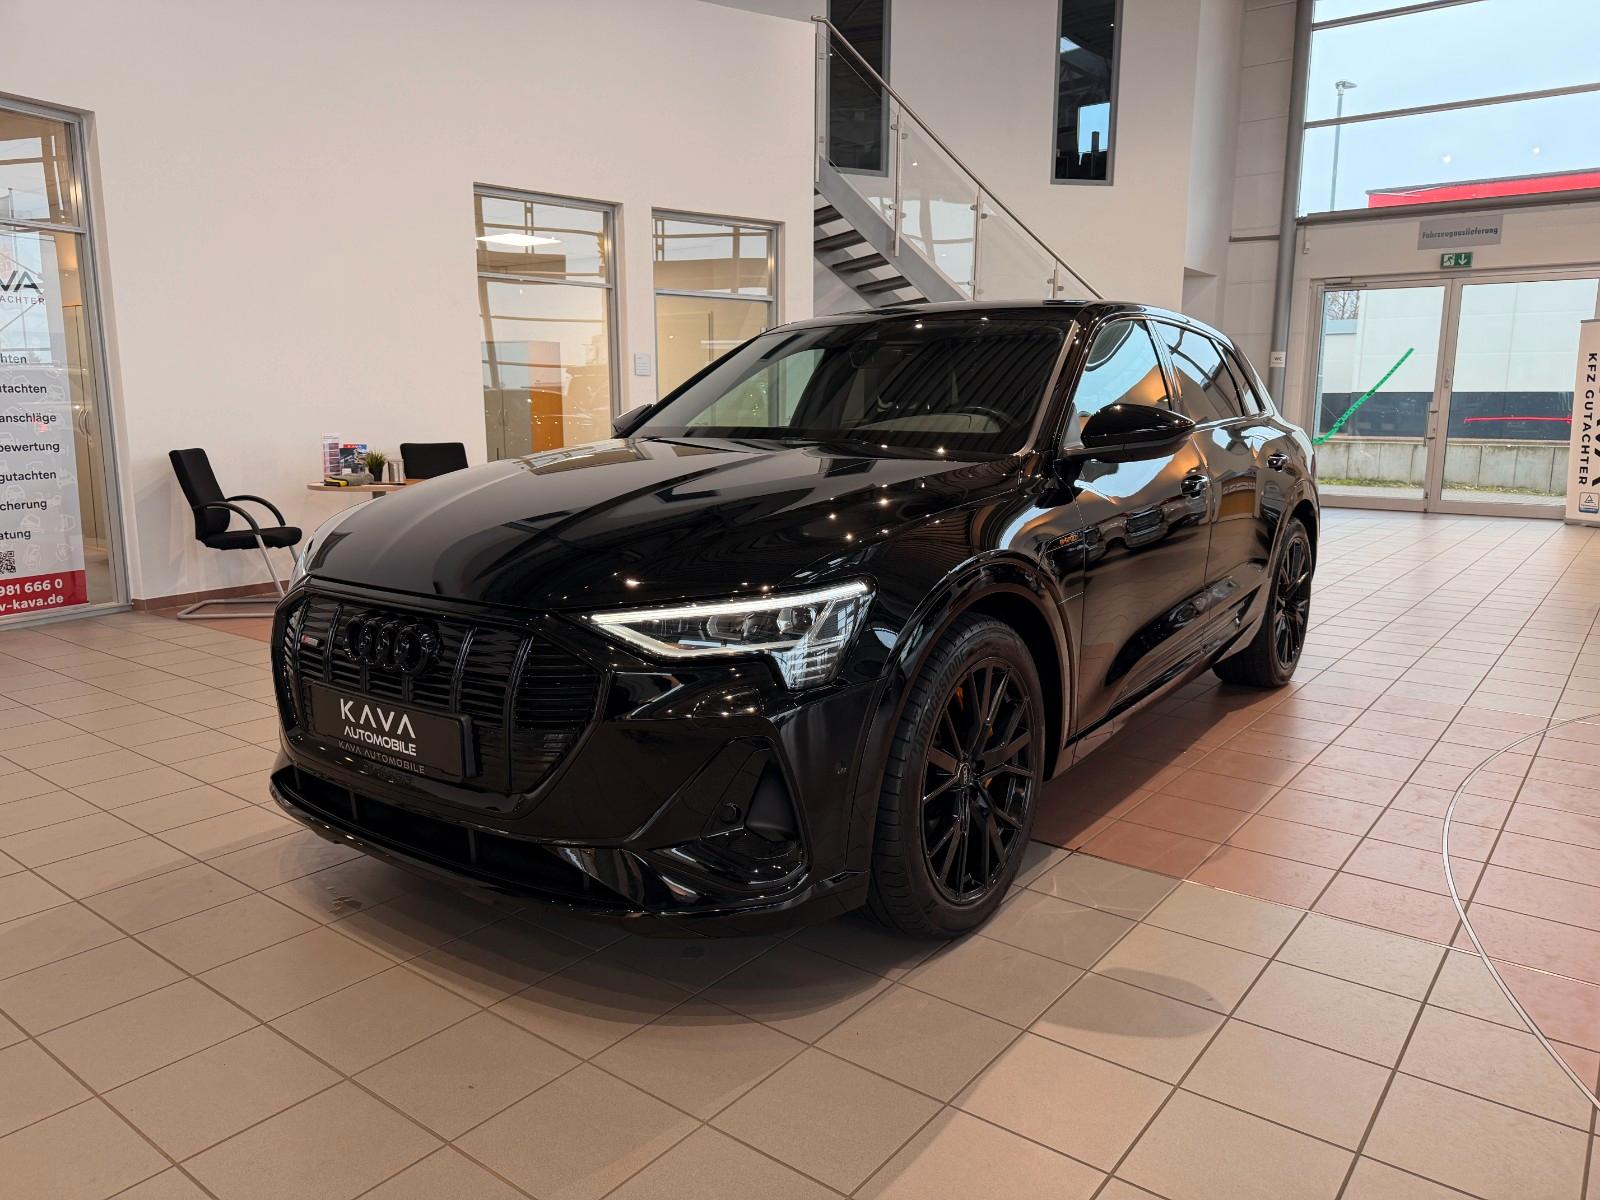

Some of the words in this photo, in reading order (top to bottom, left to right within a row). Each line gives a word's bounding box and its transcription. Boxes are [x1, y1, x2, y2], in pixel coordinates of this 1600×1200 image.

[1422, 227, 1498, 240] Fahrzeugauslieferung
[1586, 352, 1598, 383] KFZ
[0, 384, 47, 394] tachten
[0, 412, 57, 424] anschläge
[1579, 389, 1595, 485] GUTACHTER
[0, 470, 57, 484] gutachten
[0, 500, 48, 511] cherung
[0, 583, 20, 597] 981
[24, 579, 51, 593] 666
[54, 578, 63, 589] 0
[340, 698, 416, 739] KAVA
[344, 725, 417, 757] AUTOMOBILE
[338, 740, 362, 755] KAVA
[364, 749, 425, 774] AUTOMOBILE
